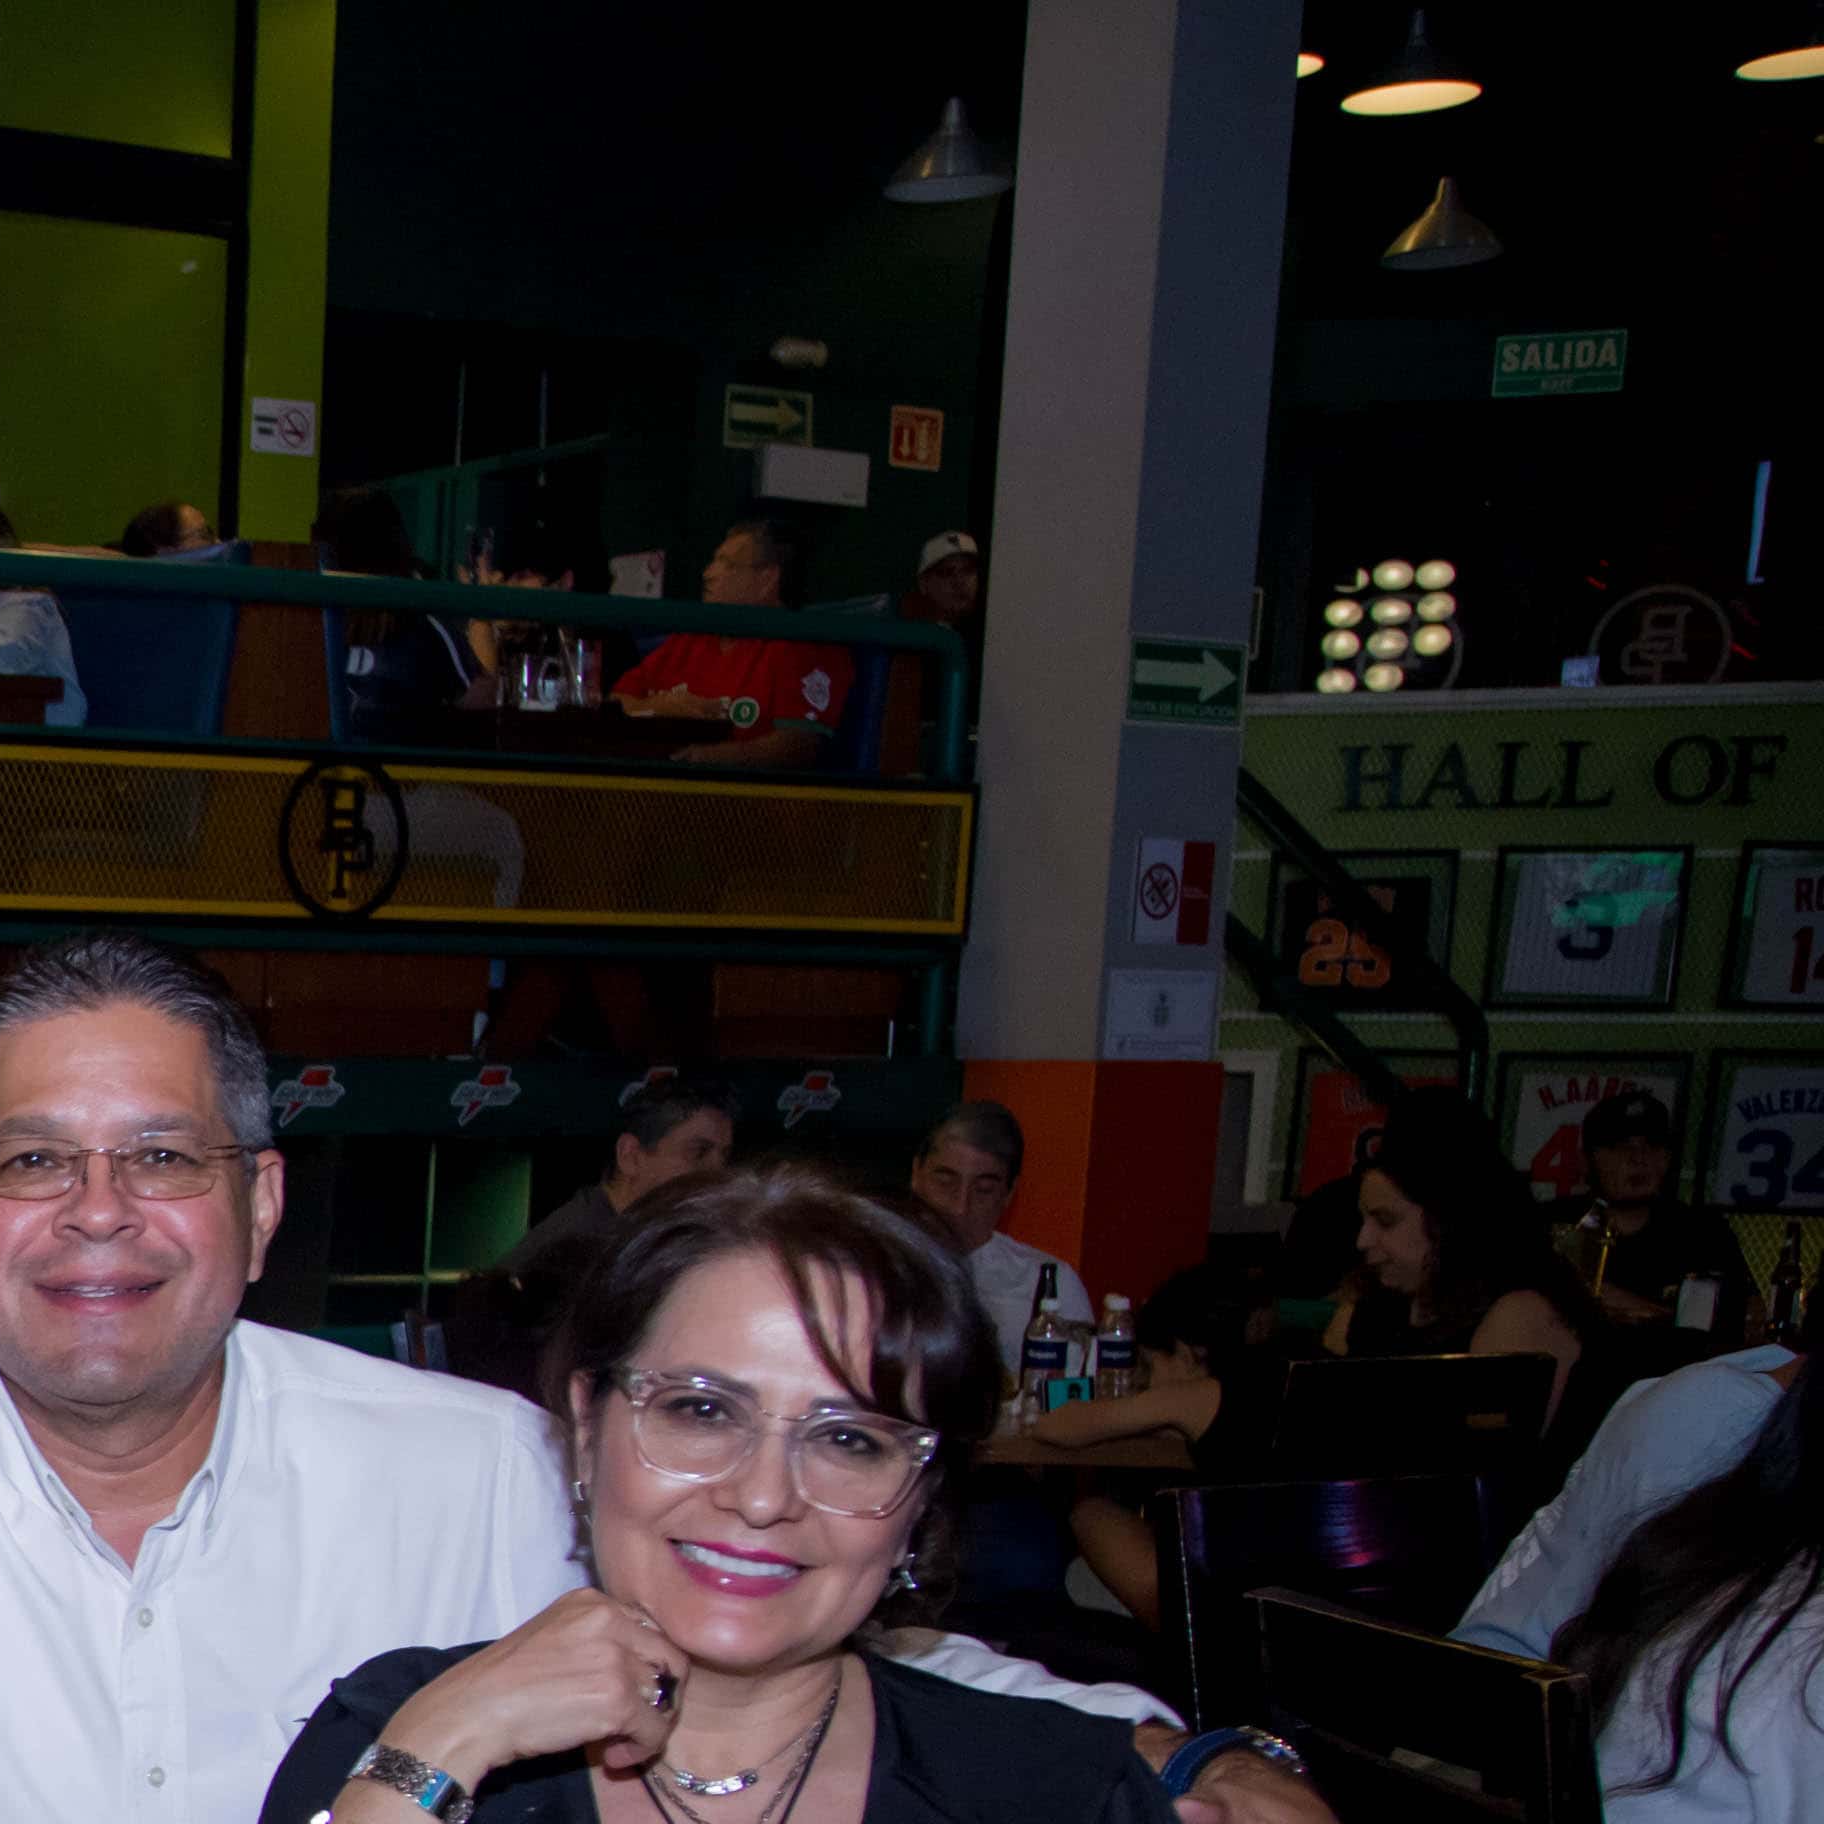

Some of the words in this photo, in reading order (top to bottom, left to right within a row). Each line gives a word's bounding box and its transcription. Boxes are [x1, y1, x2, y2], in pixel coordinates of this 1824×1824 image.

[1501, 338, 1617, 373] SALIDA
[1338, 741, 1614, 812] HALL
[1653, 734, 1788, 807] OF
